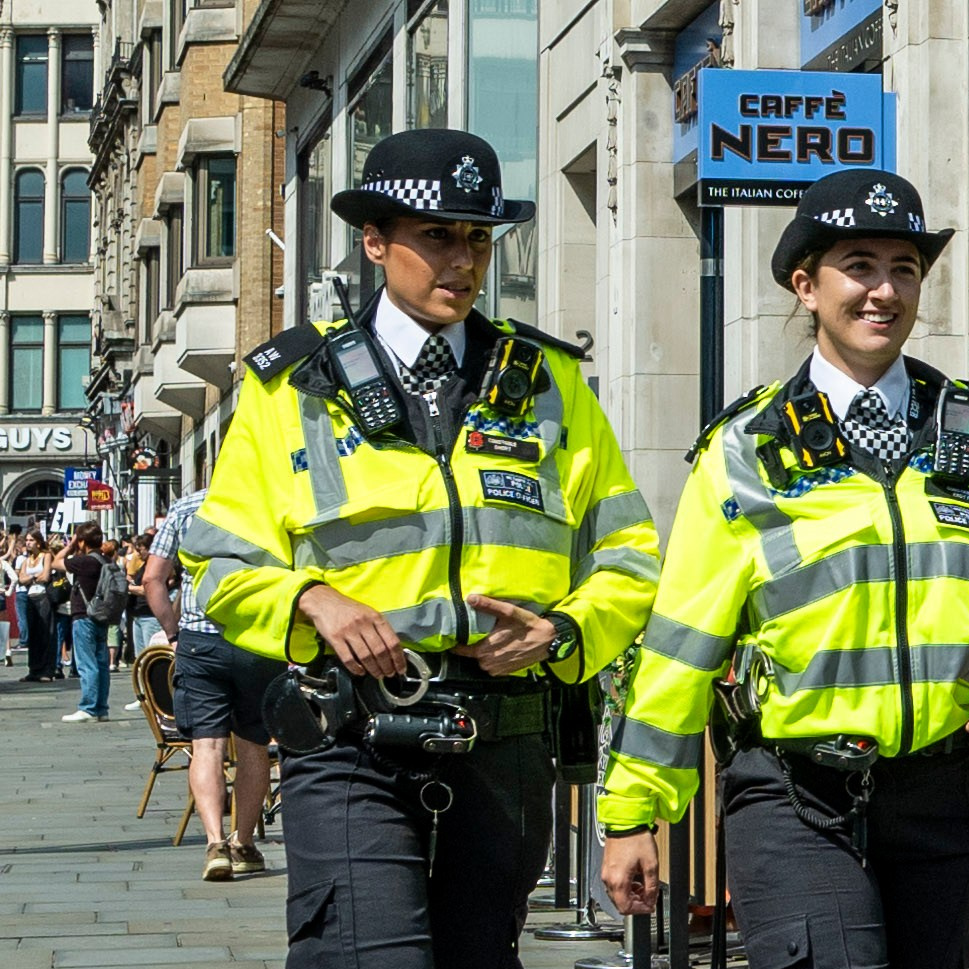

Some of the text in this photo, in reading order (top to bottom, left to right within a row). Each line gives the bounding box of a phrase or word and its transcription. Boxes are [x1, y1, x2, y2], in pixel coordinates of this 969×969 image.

[739, 89, 846, 119] CAFFÈ
[711, 123, 874, 164] NERO
[708, 187, 808, 199] THE ITALIAN COFF
[263, 347, 282, 361] AW
[487, 488, 515, 498] POLICE
